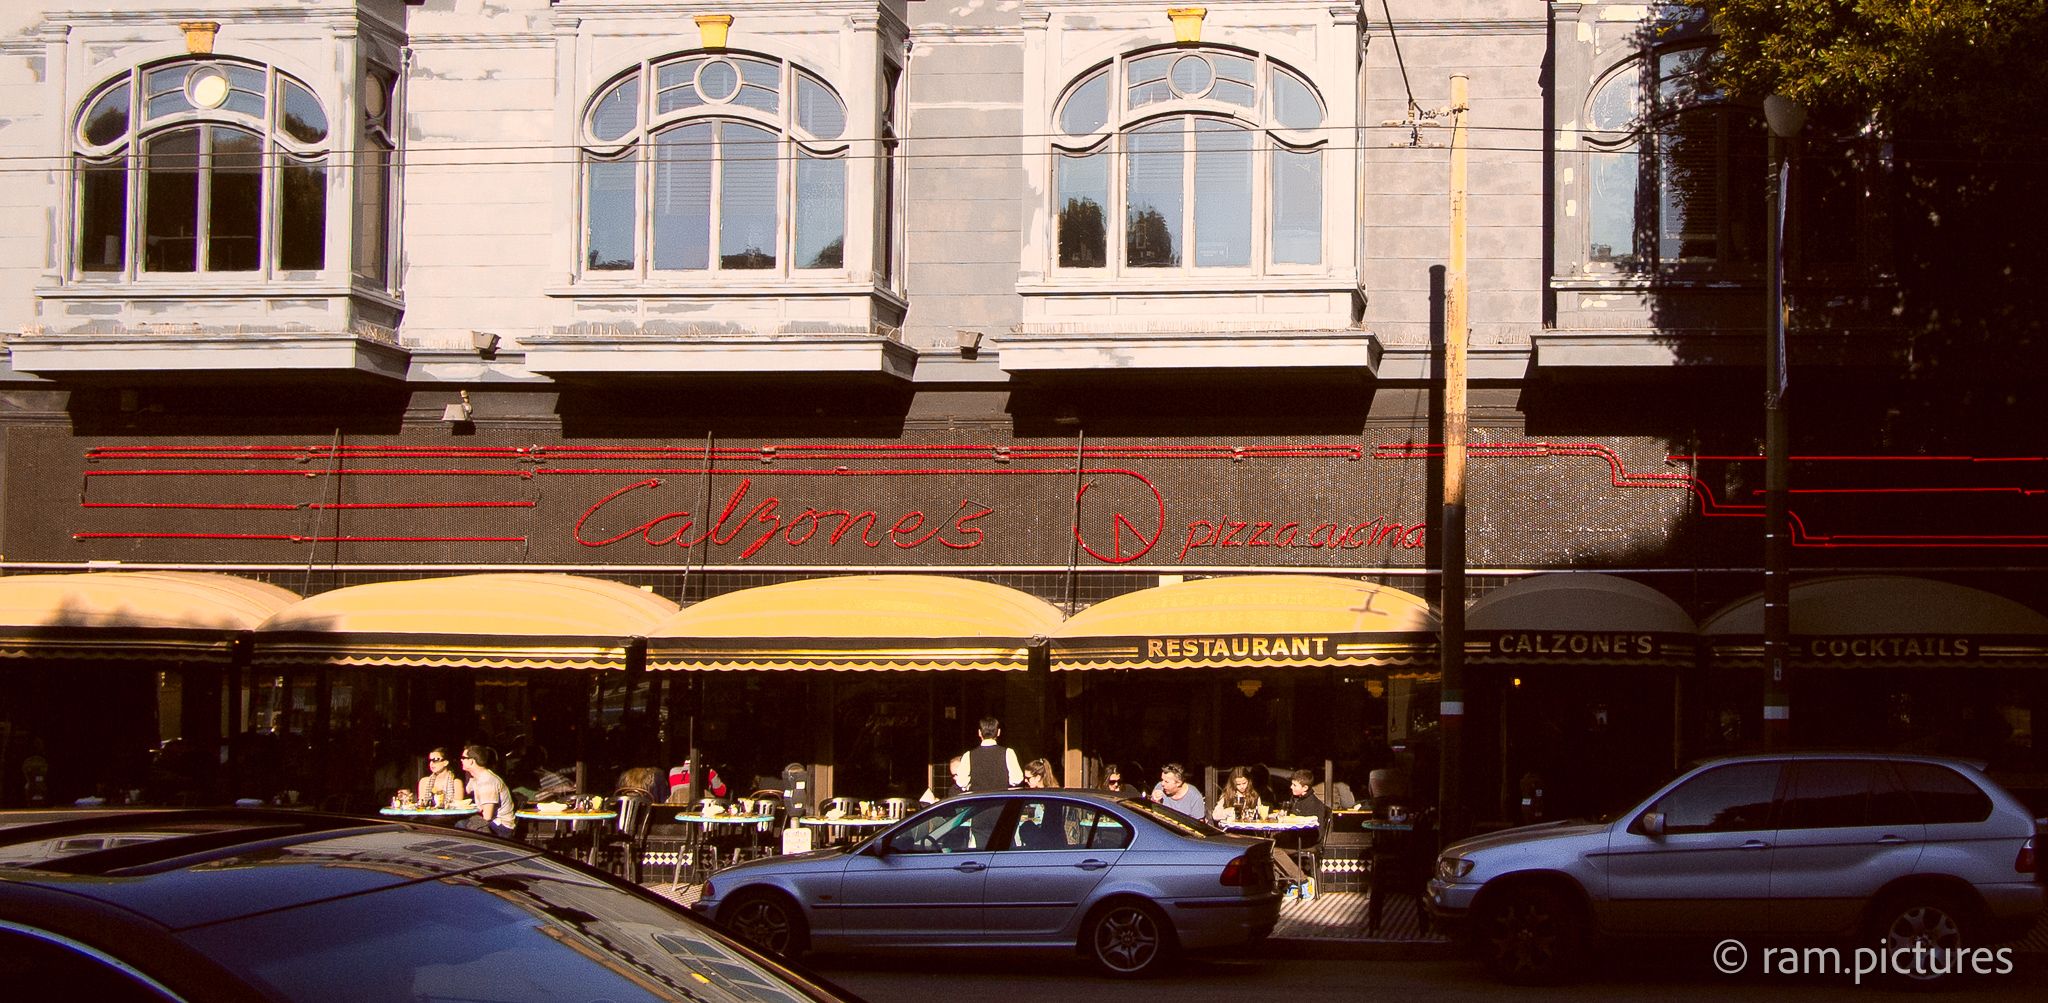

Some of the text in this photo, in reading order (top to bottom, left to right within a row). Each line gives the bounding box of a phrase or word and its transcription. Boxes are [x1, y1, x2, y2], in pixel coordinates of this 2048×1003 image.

[1178, 515, 1426, 563] pizza cucina
[1147, 636, 1330, 659] RESTAURANT
[1498, 634, 1654, 655] CALZONE'S
[1811, 637, 1970, 658] COCKTAILS
